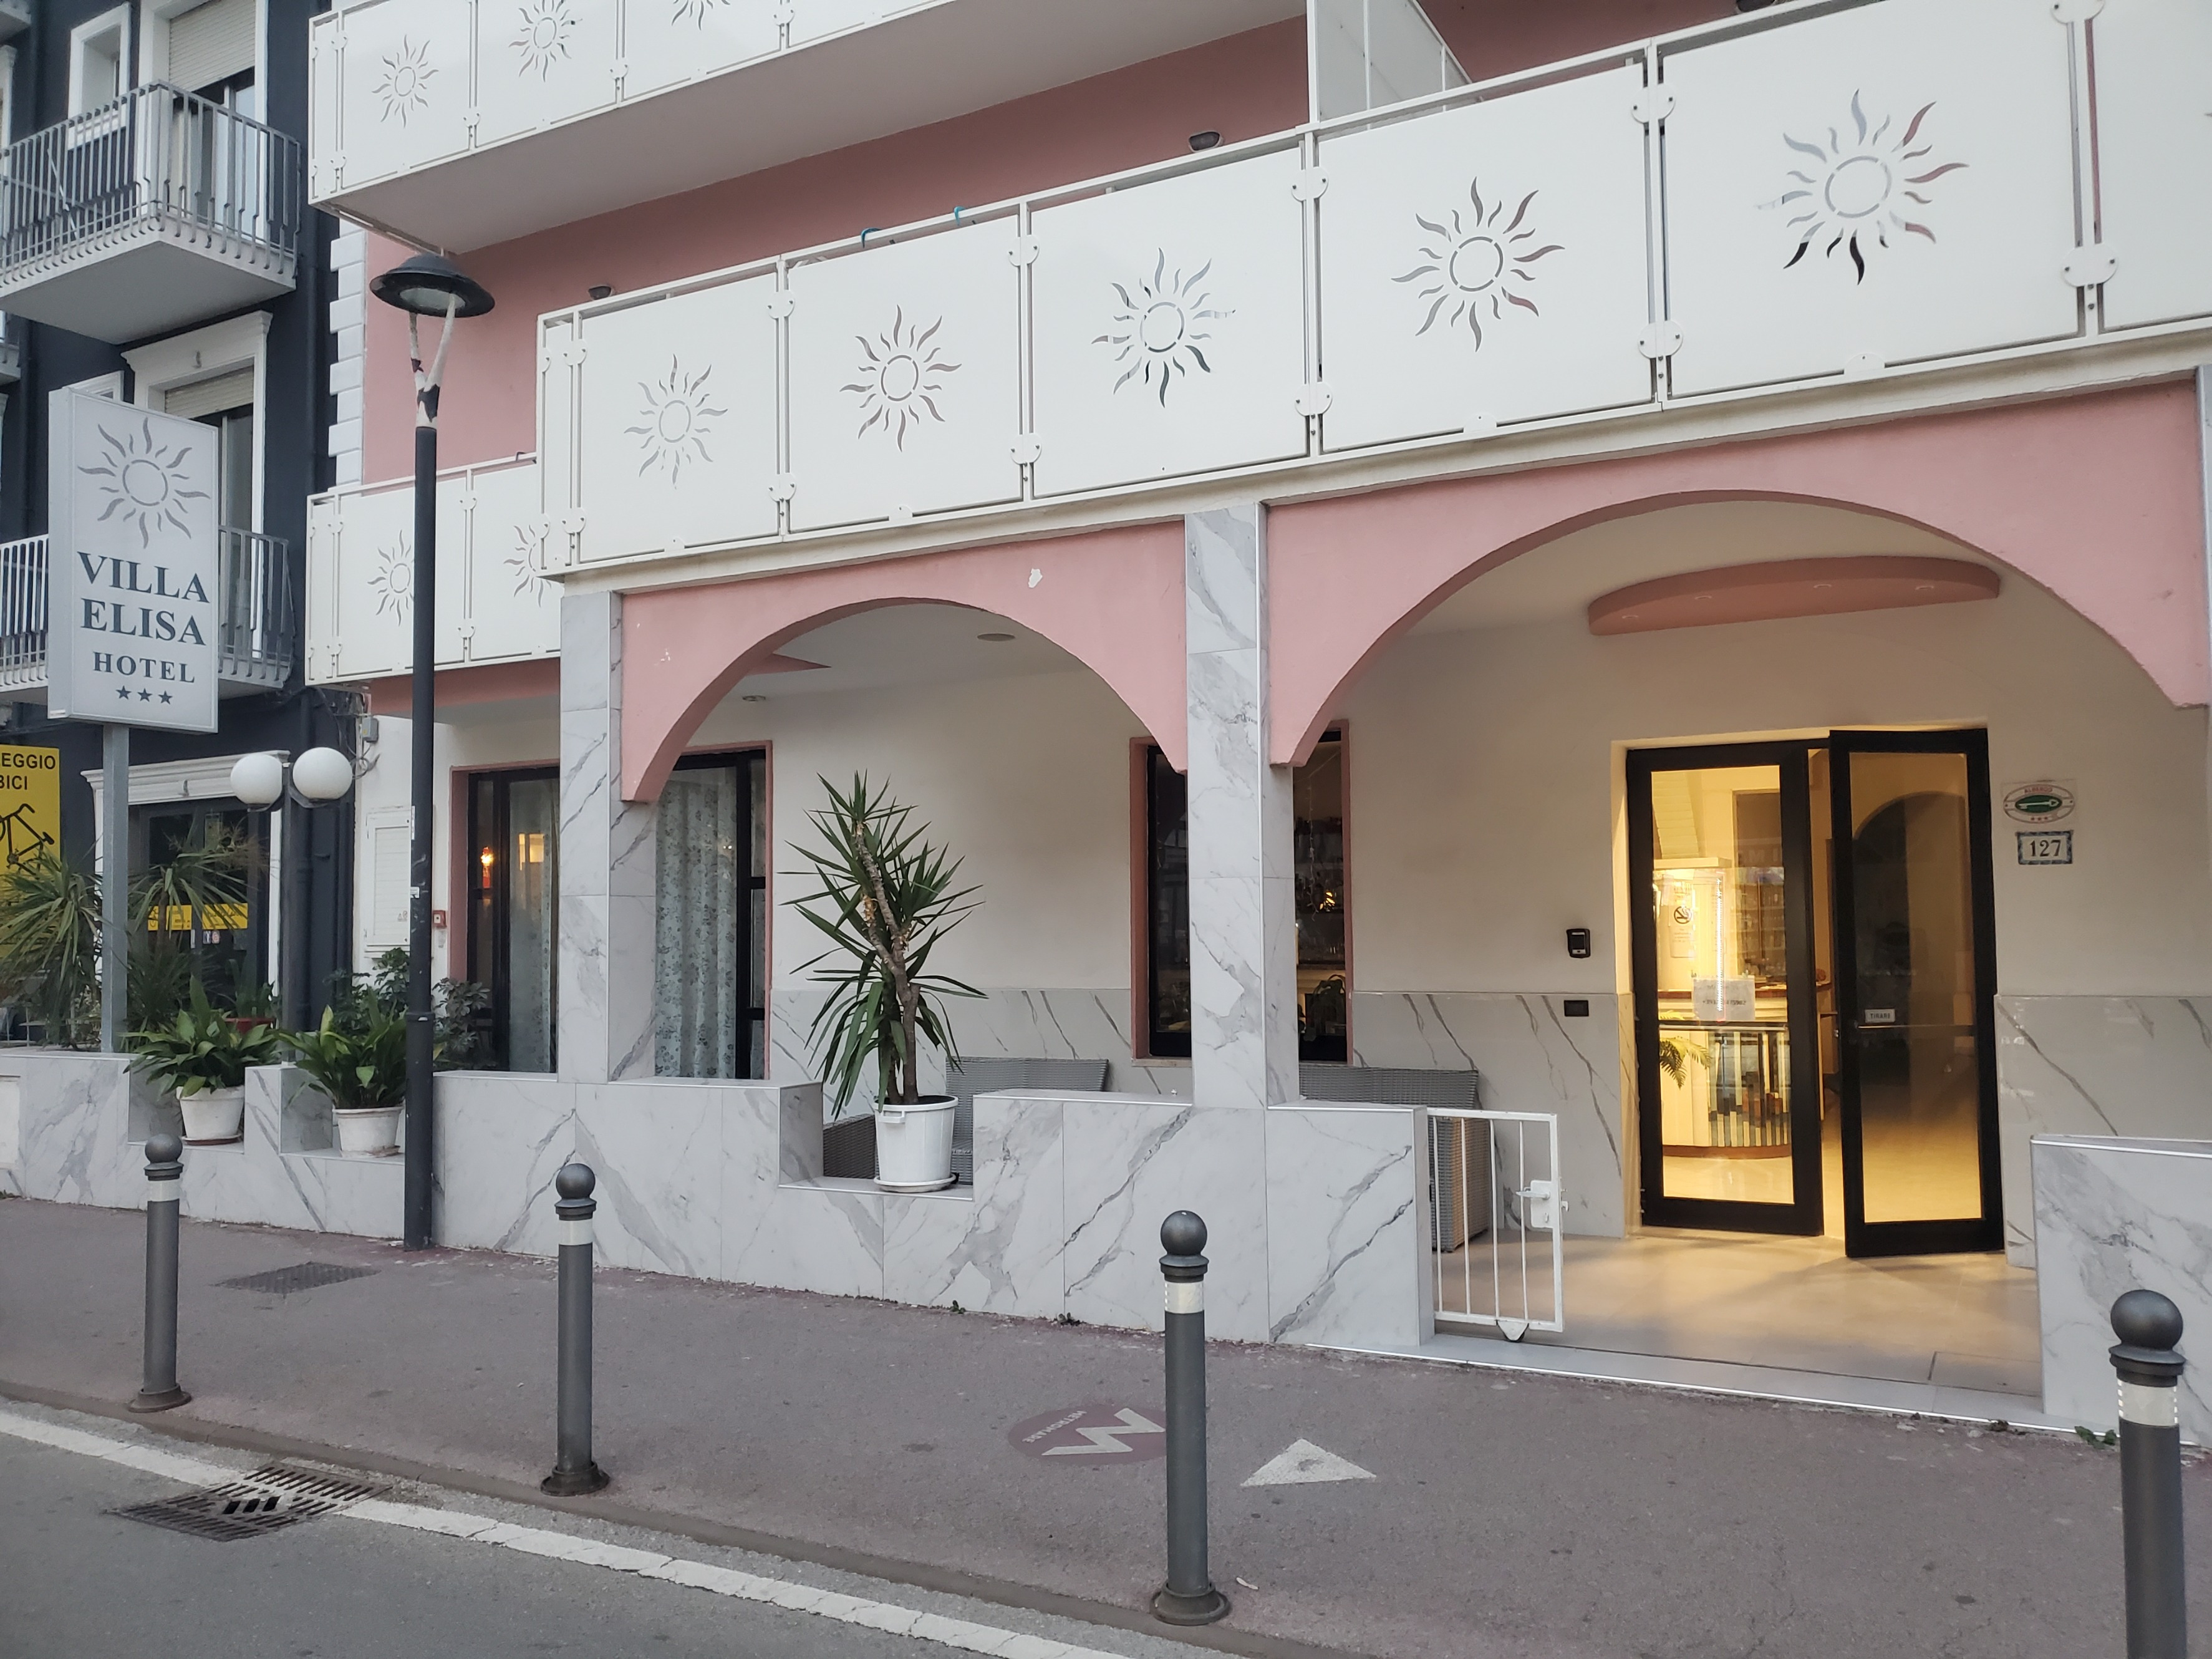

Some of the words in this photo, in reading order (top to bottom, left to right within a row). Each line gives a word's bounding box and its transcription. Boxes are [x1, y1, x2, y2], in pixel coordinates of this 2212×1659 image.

[77, 551, 210, 603] VILLA
[80, 597, 206, 646] ELISA
[93, 652, 195, 683] HOTEL
[1, 752, 56, 770] EGGIO
[2029, 839, 2061, 857] 127
